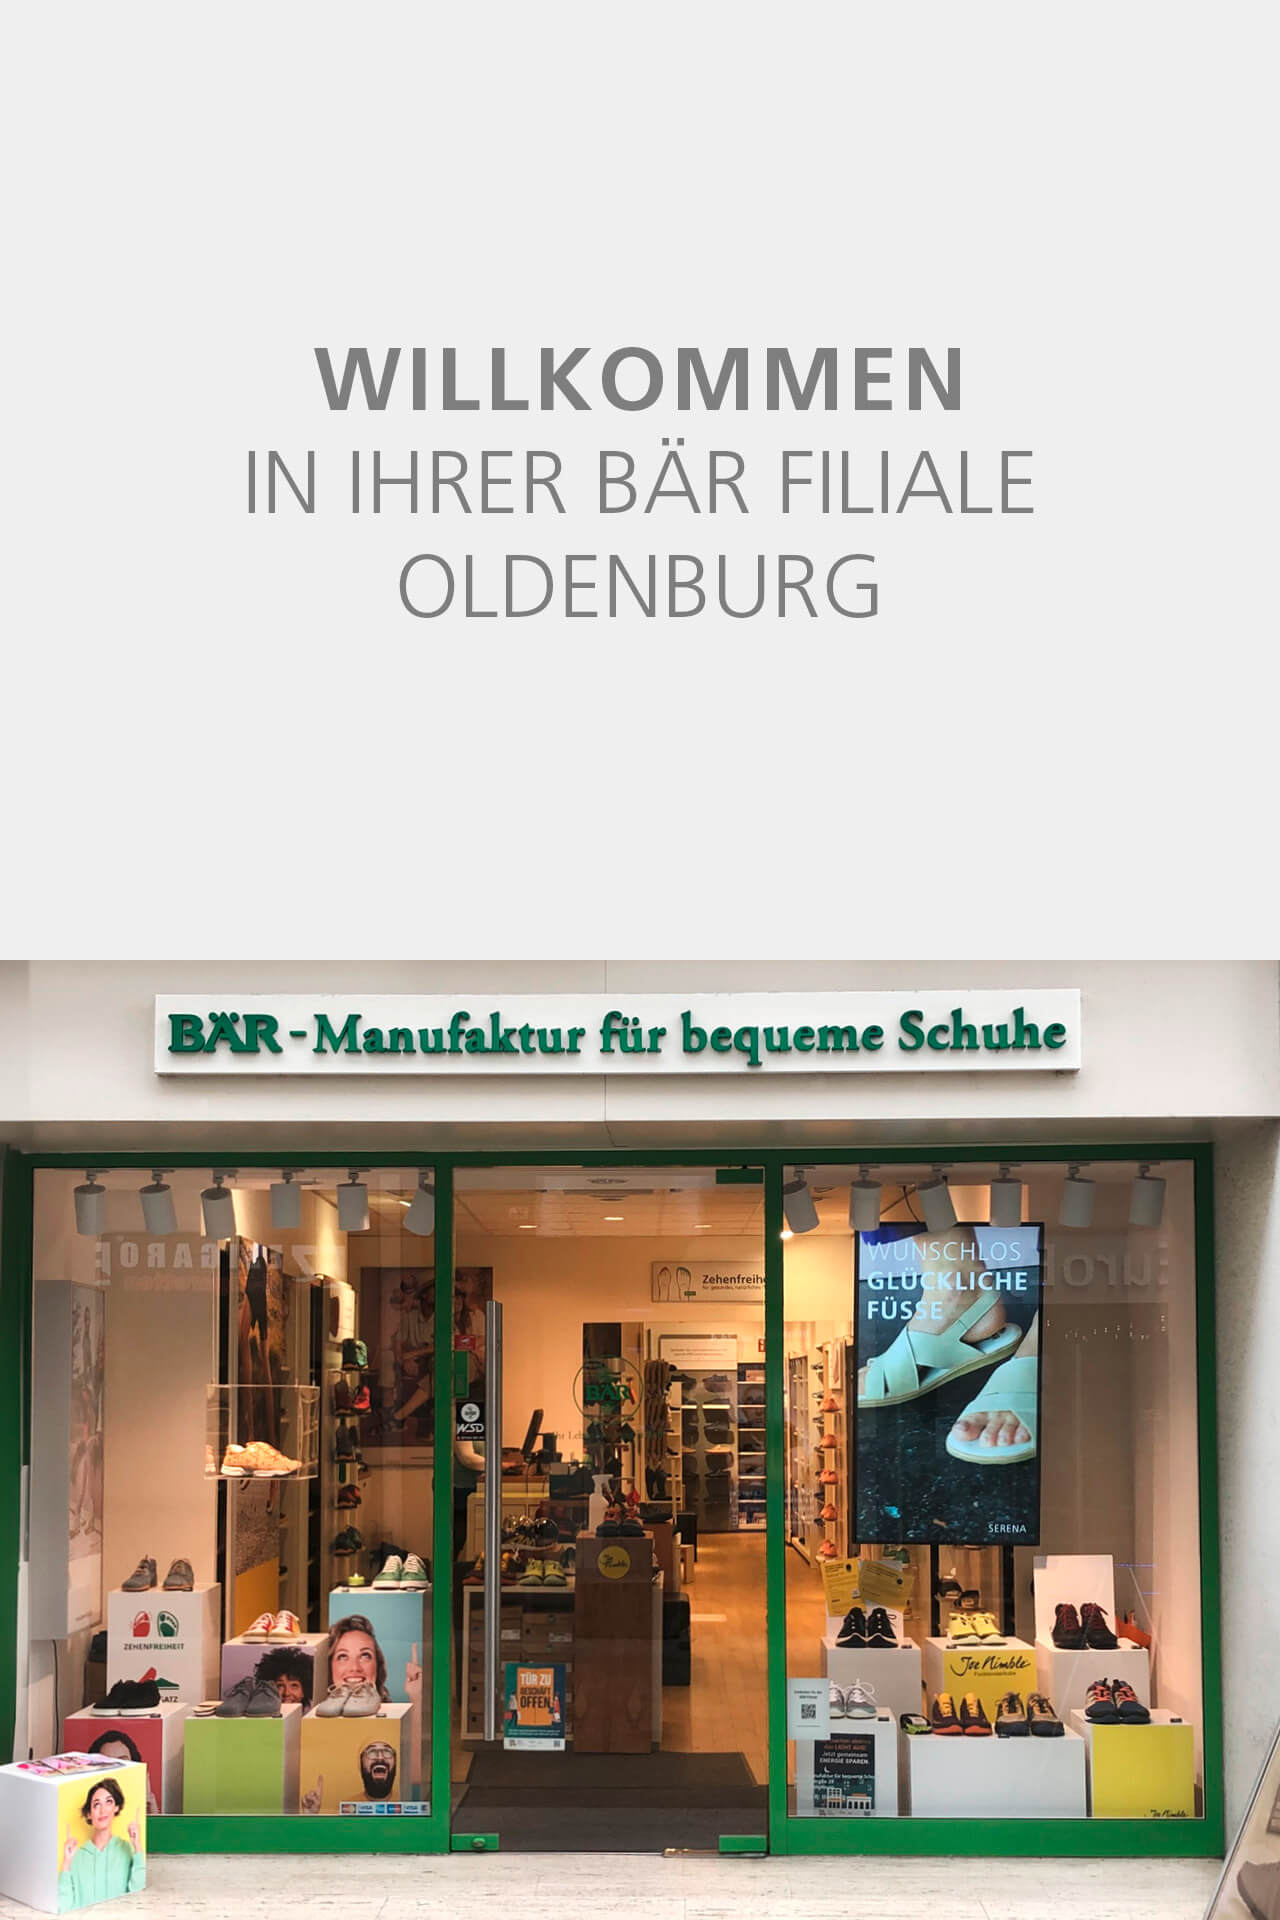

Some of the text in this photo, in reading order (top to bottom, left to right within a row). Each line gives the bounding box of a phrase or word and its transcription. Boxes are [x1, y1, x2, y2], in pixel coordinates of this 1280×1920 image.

[600, 1009, 667, 1052] für
[682, 1011, 884, 1065] bequeme
[898, 1008, 1066, 1051] Schuhe
[867, 1241, 1022, 1261] WUNSCHLOS
[867, 1267, 1028, 1291] GLÜCKLICHE
[867, 1296, 944, 1320] FÜSSE
[456, 1423, 485, 1435] WSD
[988, 1523, 1027, 1533] SERENA
[950, 1655, 1031, 1677] Joe Nimble
[520, 1671, 552, 1686] TÜR ZU
